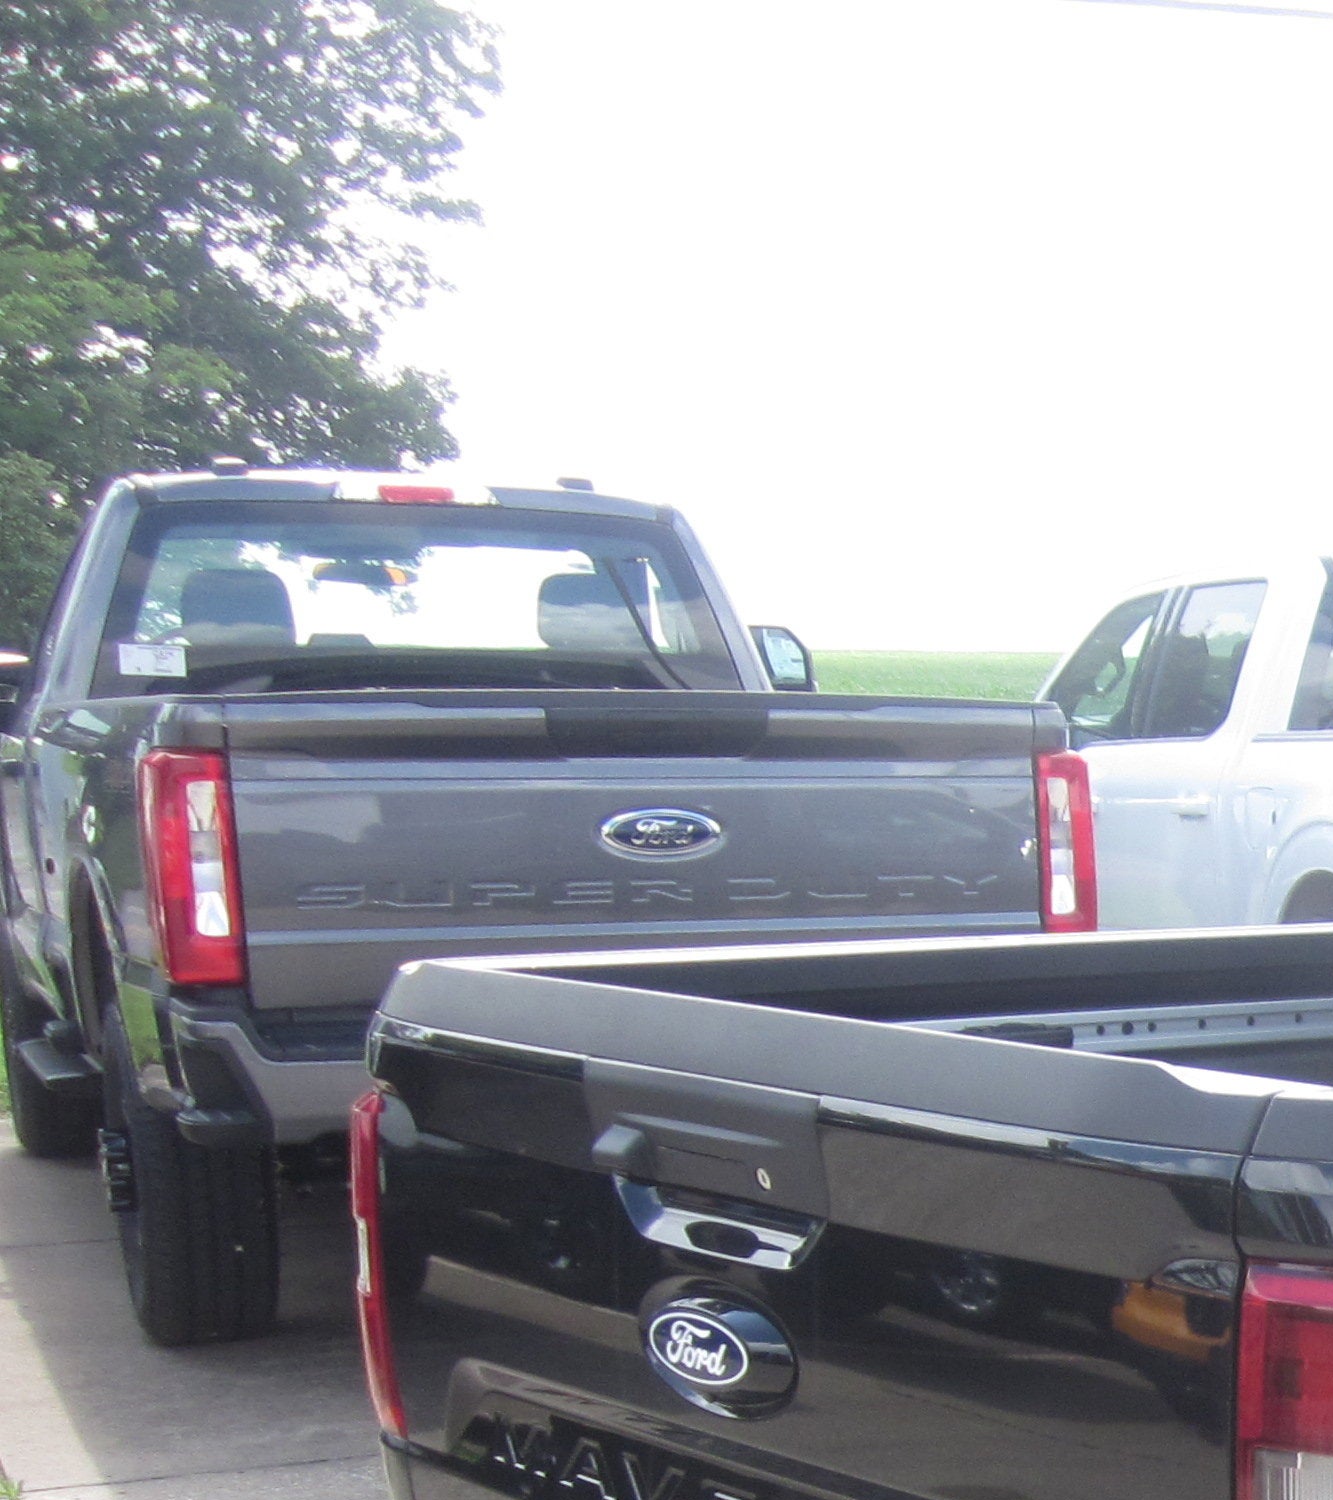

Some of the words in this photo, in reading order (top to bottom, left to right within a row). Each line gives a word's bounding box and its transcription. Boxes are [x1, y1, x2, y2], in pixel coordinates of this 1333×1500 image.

[296, 879, 694, 911] SUPER
[728, 873, 998, 901] DUTY
[666, 1320, 728, 1376] Ford
